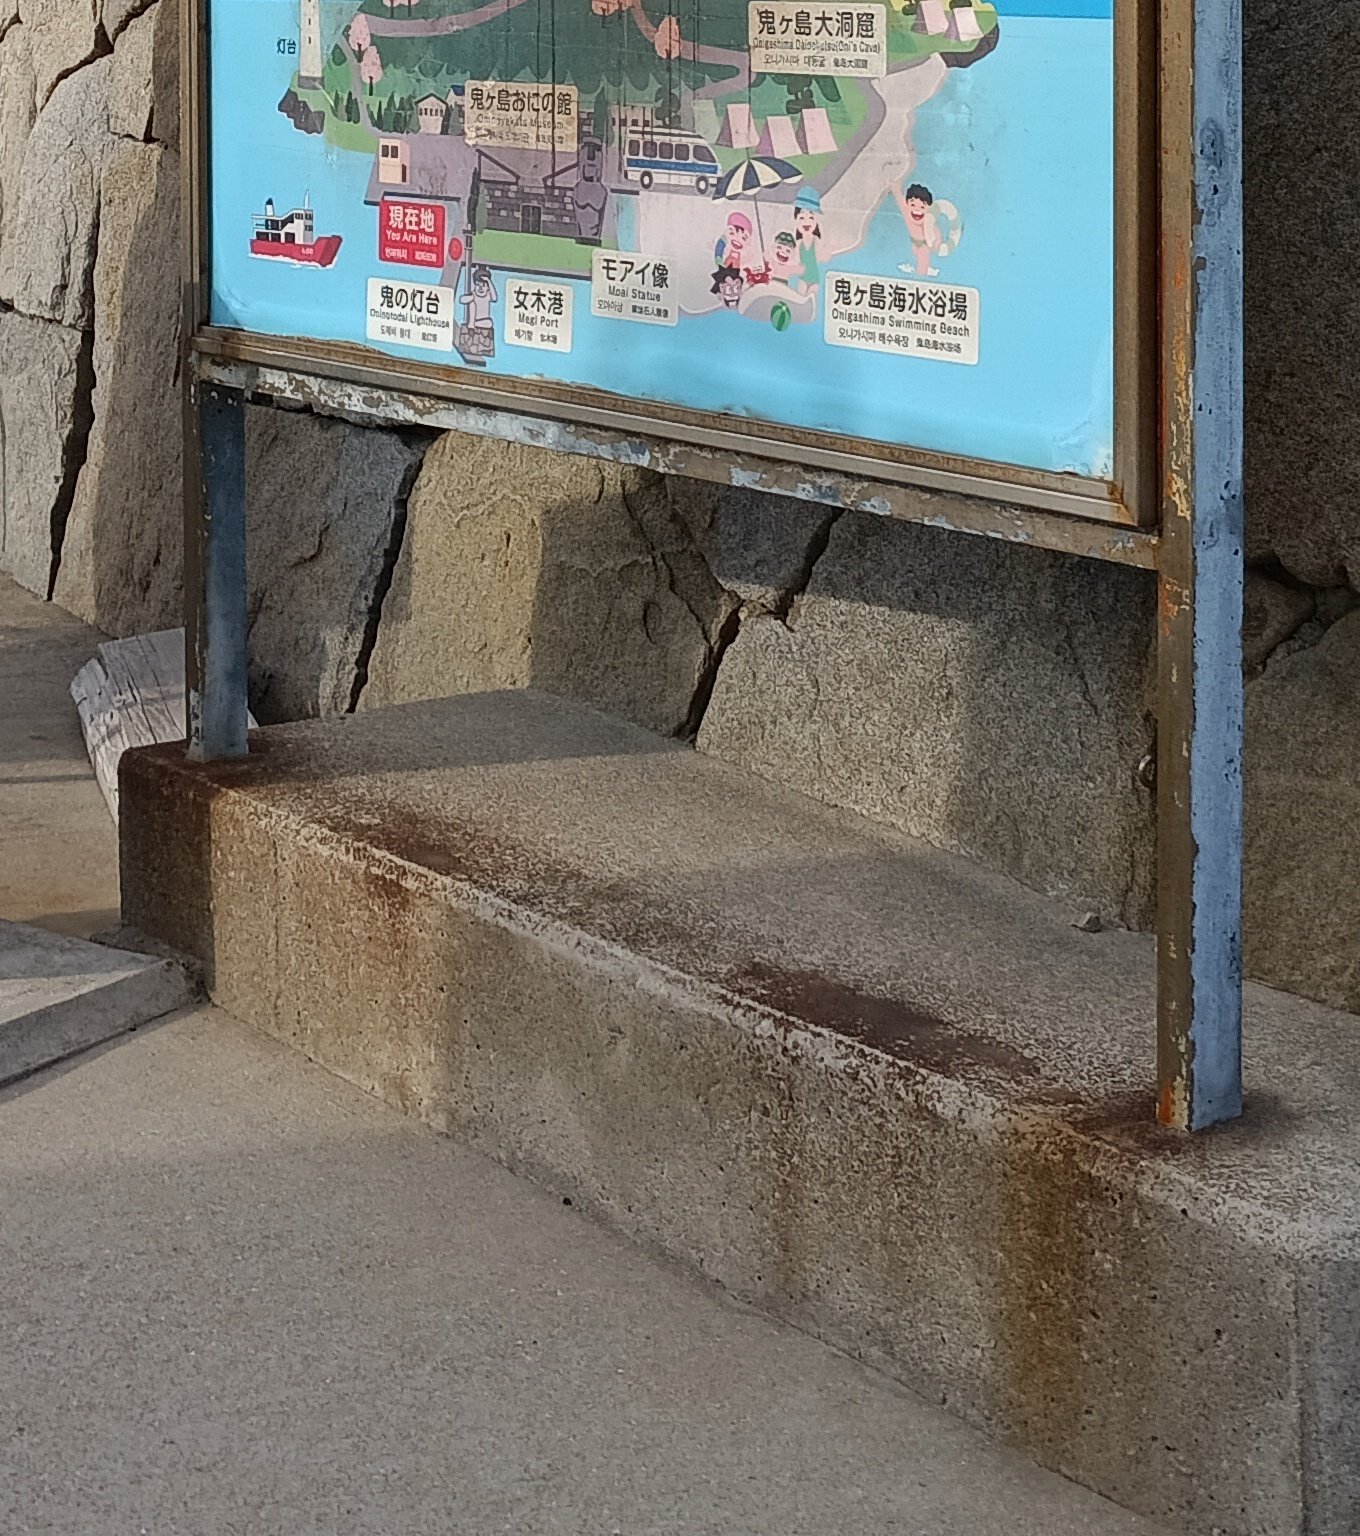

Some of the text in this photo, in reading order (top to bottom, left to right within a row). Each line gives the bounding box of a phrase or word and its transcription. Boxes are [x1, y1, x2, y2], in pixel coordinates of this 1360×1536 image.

[277, 38, 296, 54] 灯台
[389, 206, 434, 232] 現在地
[602, 258, 669, 288] モアイ像
[380, 285, 440, 314] 鬼の灯台
[514, 286, 563, 315] 女木港
[631, 289, 661, 301] Statue
[834, 278, 967, 321] 鬼ヶ島海水浴場
[540, 315, 558, 328] Port
[832, 308, 970, 337] Onigashima Swimming Beach
